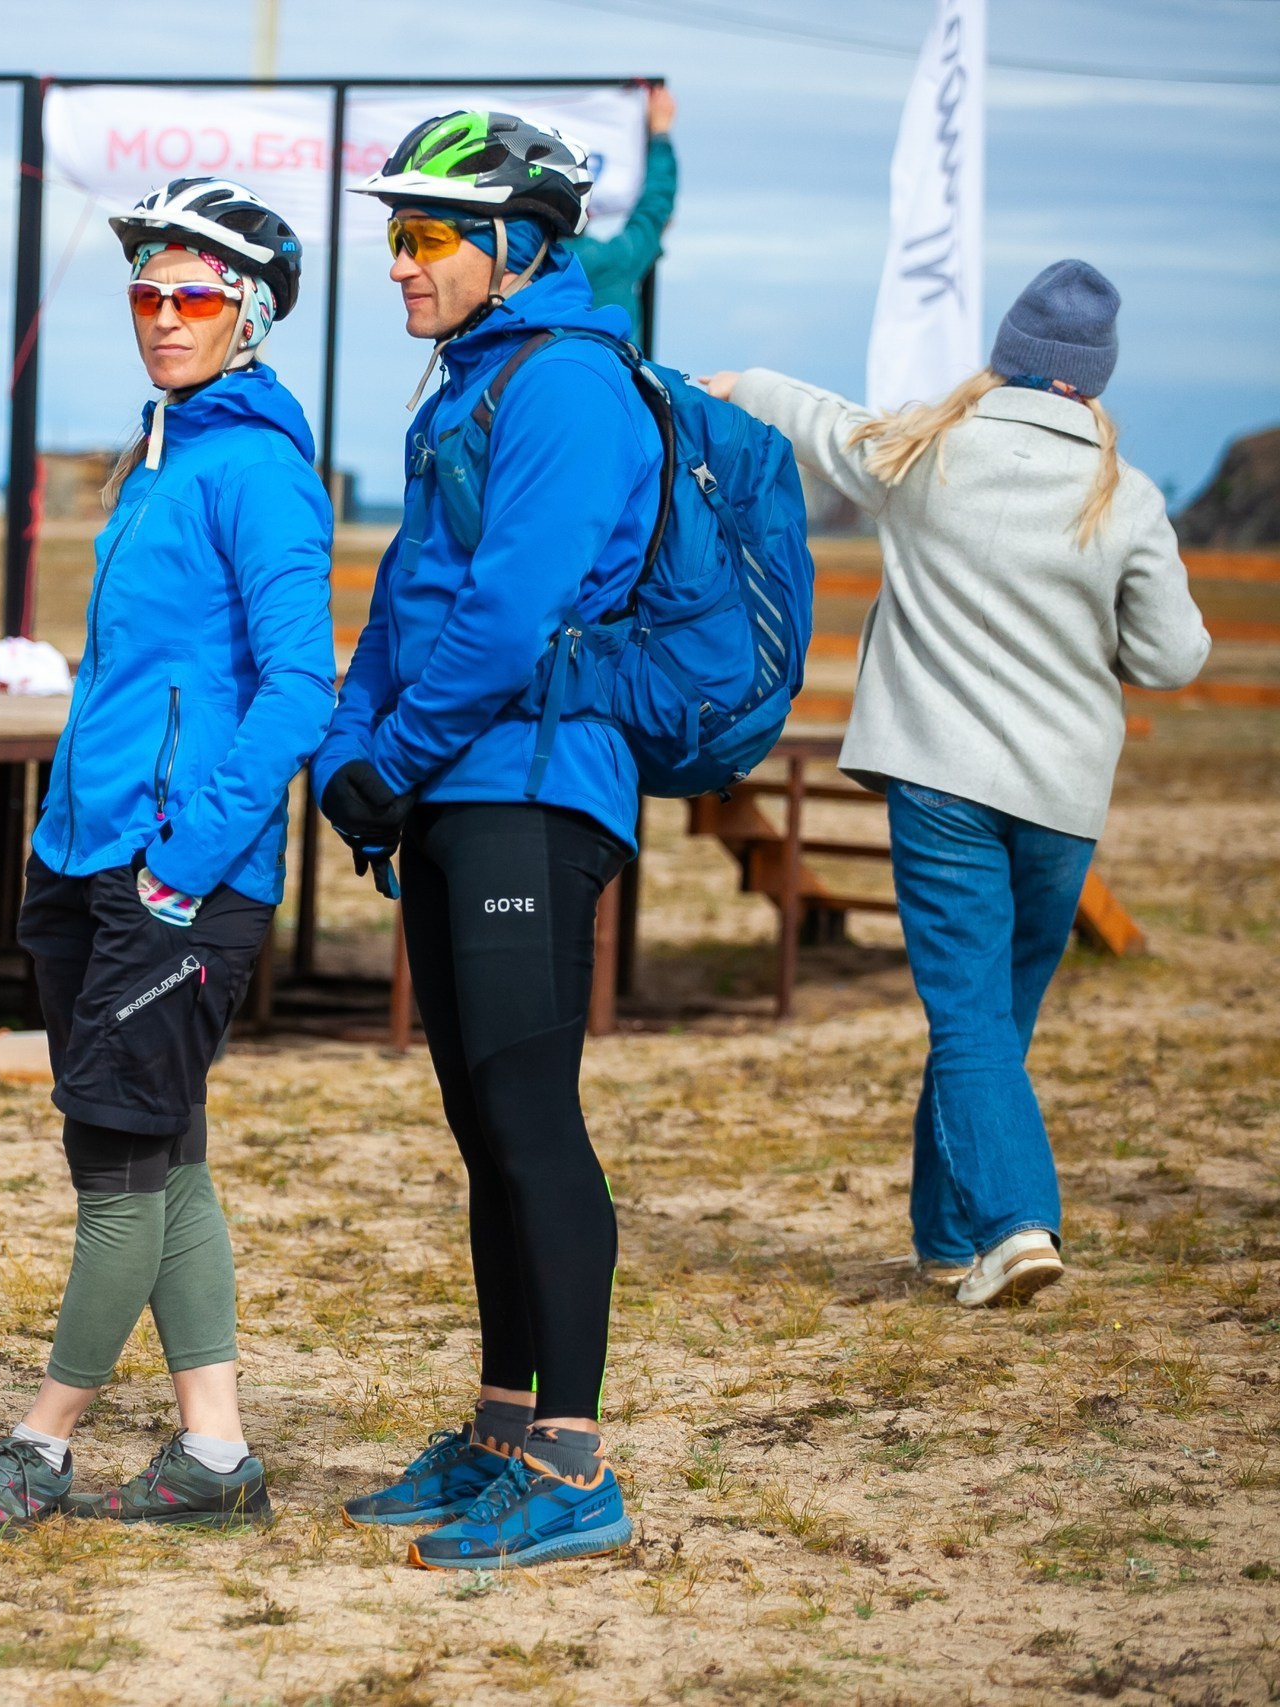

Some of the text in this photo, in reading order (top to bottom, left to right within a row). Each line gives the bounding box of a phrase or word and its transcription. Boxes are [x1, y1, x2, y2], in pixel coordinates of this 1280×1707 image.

[484, 897, 535, 913] GORE
[115, 964, 196, 1021] ENDURA
[581, 1492, 618, 1515] SCOTT
